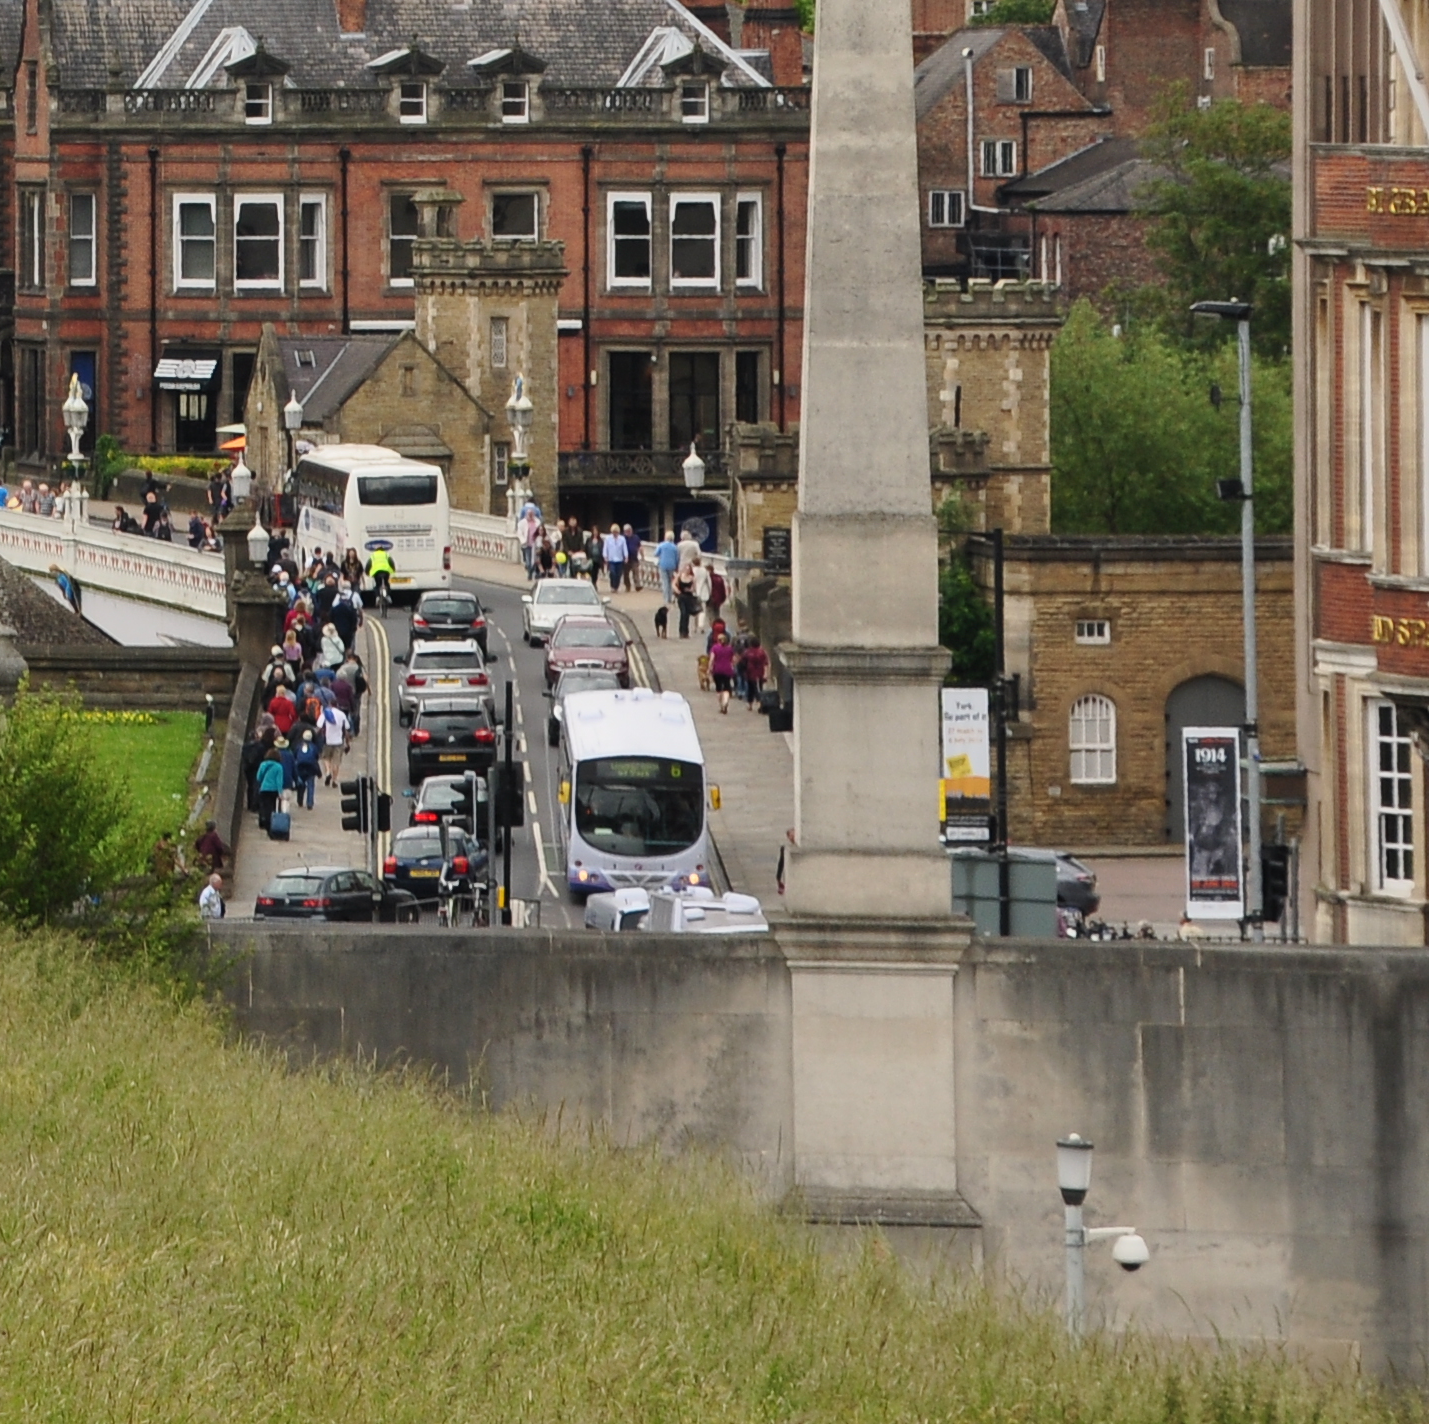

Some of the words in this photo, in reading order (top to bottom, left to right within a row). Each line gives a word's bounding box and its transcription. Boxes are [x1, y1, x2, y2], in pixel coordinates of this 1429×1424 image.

[1396, 617, 1429, 648] SP
[1194, 747, 1227, 763] 1914
[671, 763, 682, 778] 6
